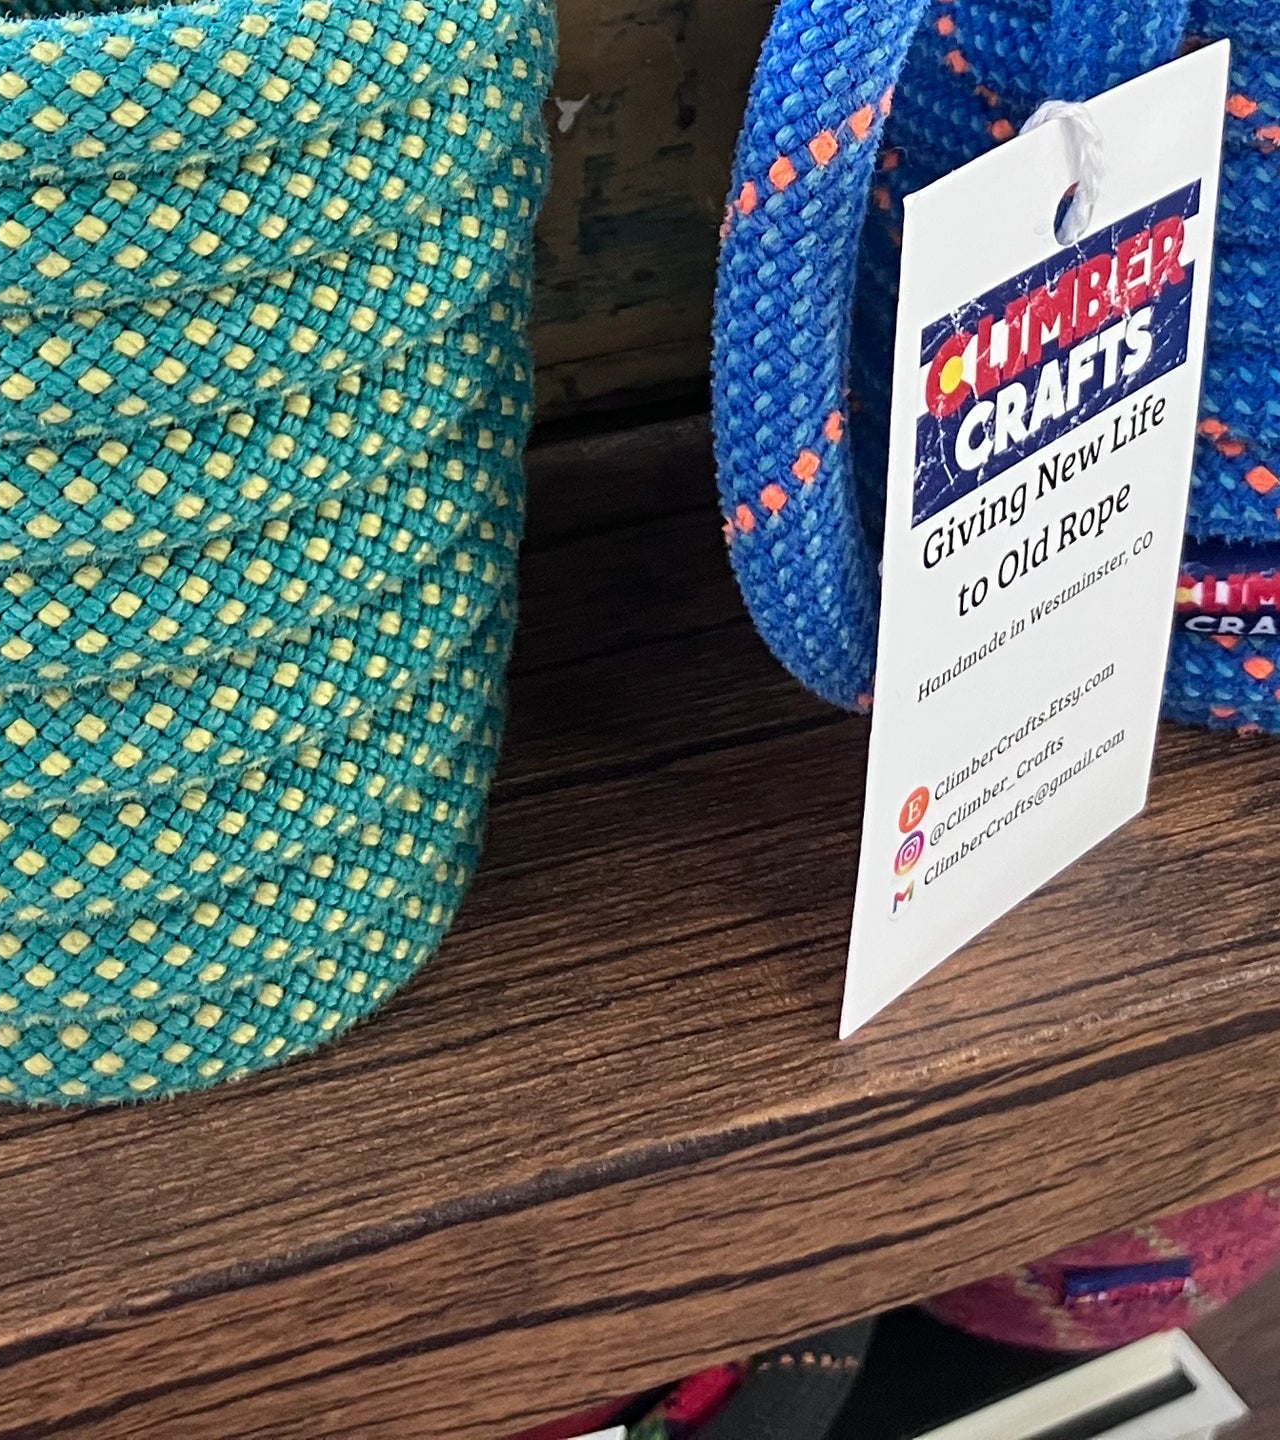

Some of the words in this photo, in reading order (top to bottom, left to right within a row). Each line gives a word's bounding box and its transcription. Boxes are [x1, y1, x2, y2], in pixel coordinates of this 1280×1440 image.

[926, 215, 1186, 417] CLIMBER
[955, 307, 1154, 472] CRAFTS
[923, 481, 1028, 570] Giving
[1036, 435, 1104, 500] New
[1111, 395, 1166, 454] Life
[958, 576, 988, 616] to
[998, 537, 1049, 586] Old
[1057, 484, 1131, 553] Rope
[918, 626, 1006, 702] Handmade
[1010, 617, 1025, 639] in
[1029, 550, 1128, 628] Westminster,
[1132, 531, 1153, 557] CO
[924, 730, 1125, 886] ClimberCrafts@gmail.com
[930, 736, 1064, 846] @Climber_Crafts
[935, 662, 1115, 801] ClimberCrafts.Etsy.com
